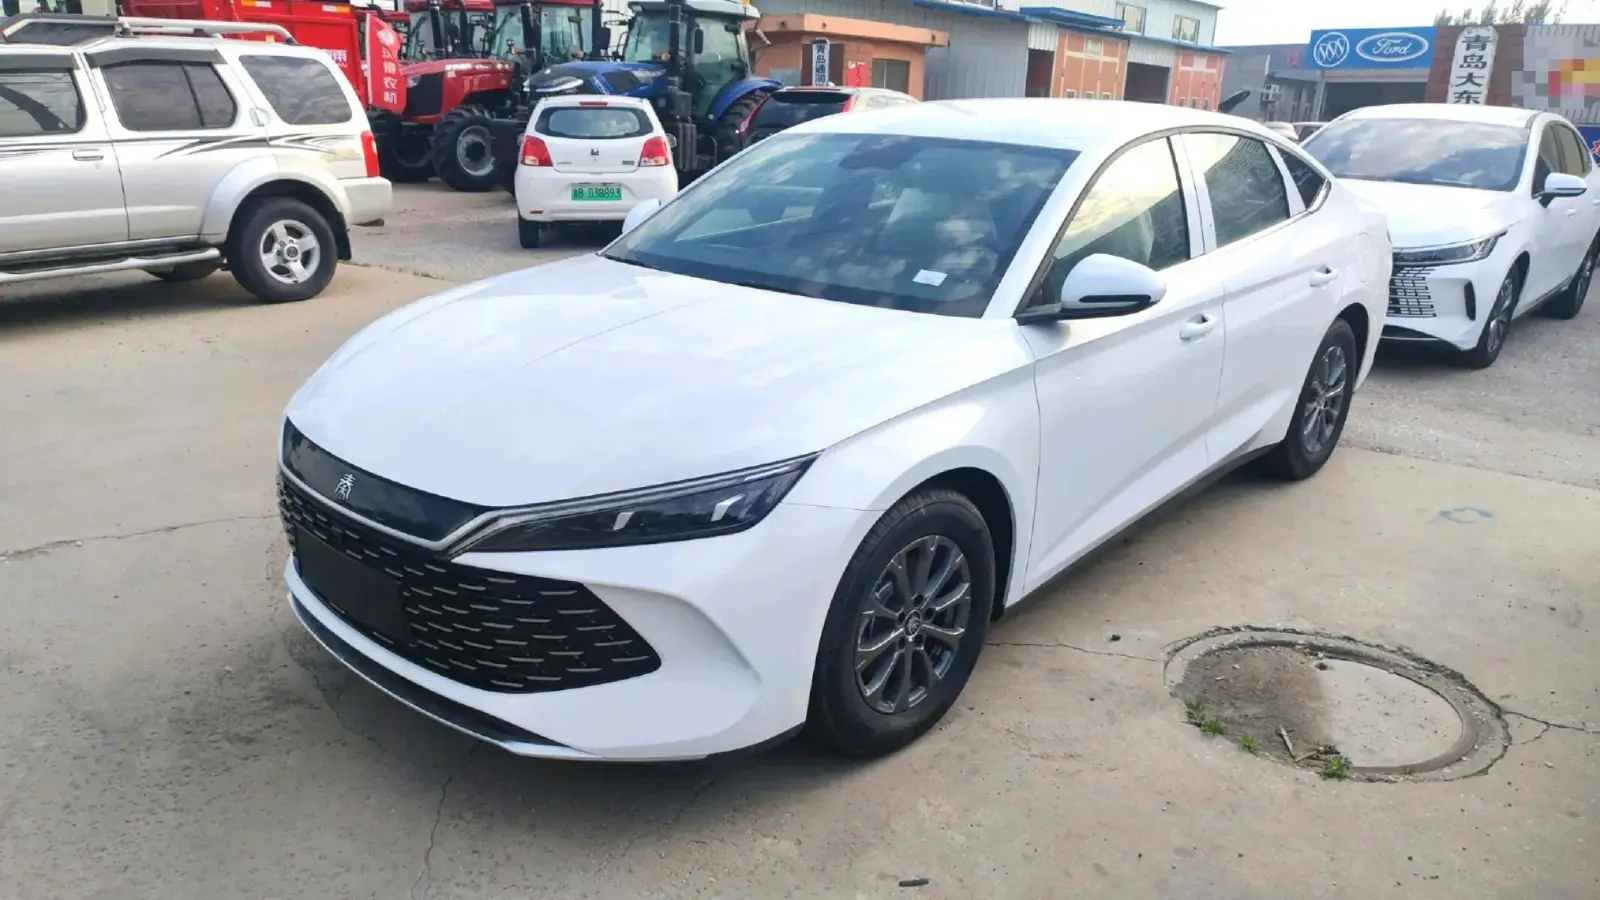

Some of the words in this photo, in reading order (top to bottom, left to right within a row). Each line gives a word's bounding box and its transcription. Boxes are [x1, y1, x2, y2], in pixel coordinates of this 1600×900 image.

[1372, 38, 1413, 56] Ford
[1453, 34, 1491, 104] 青岛大东
